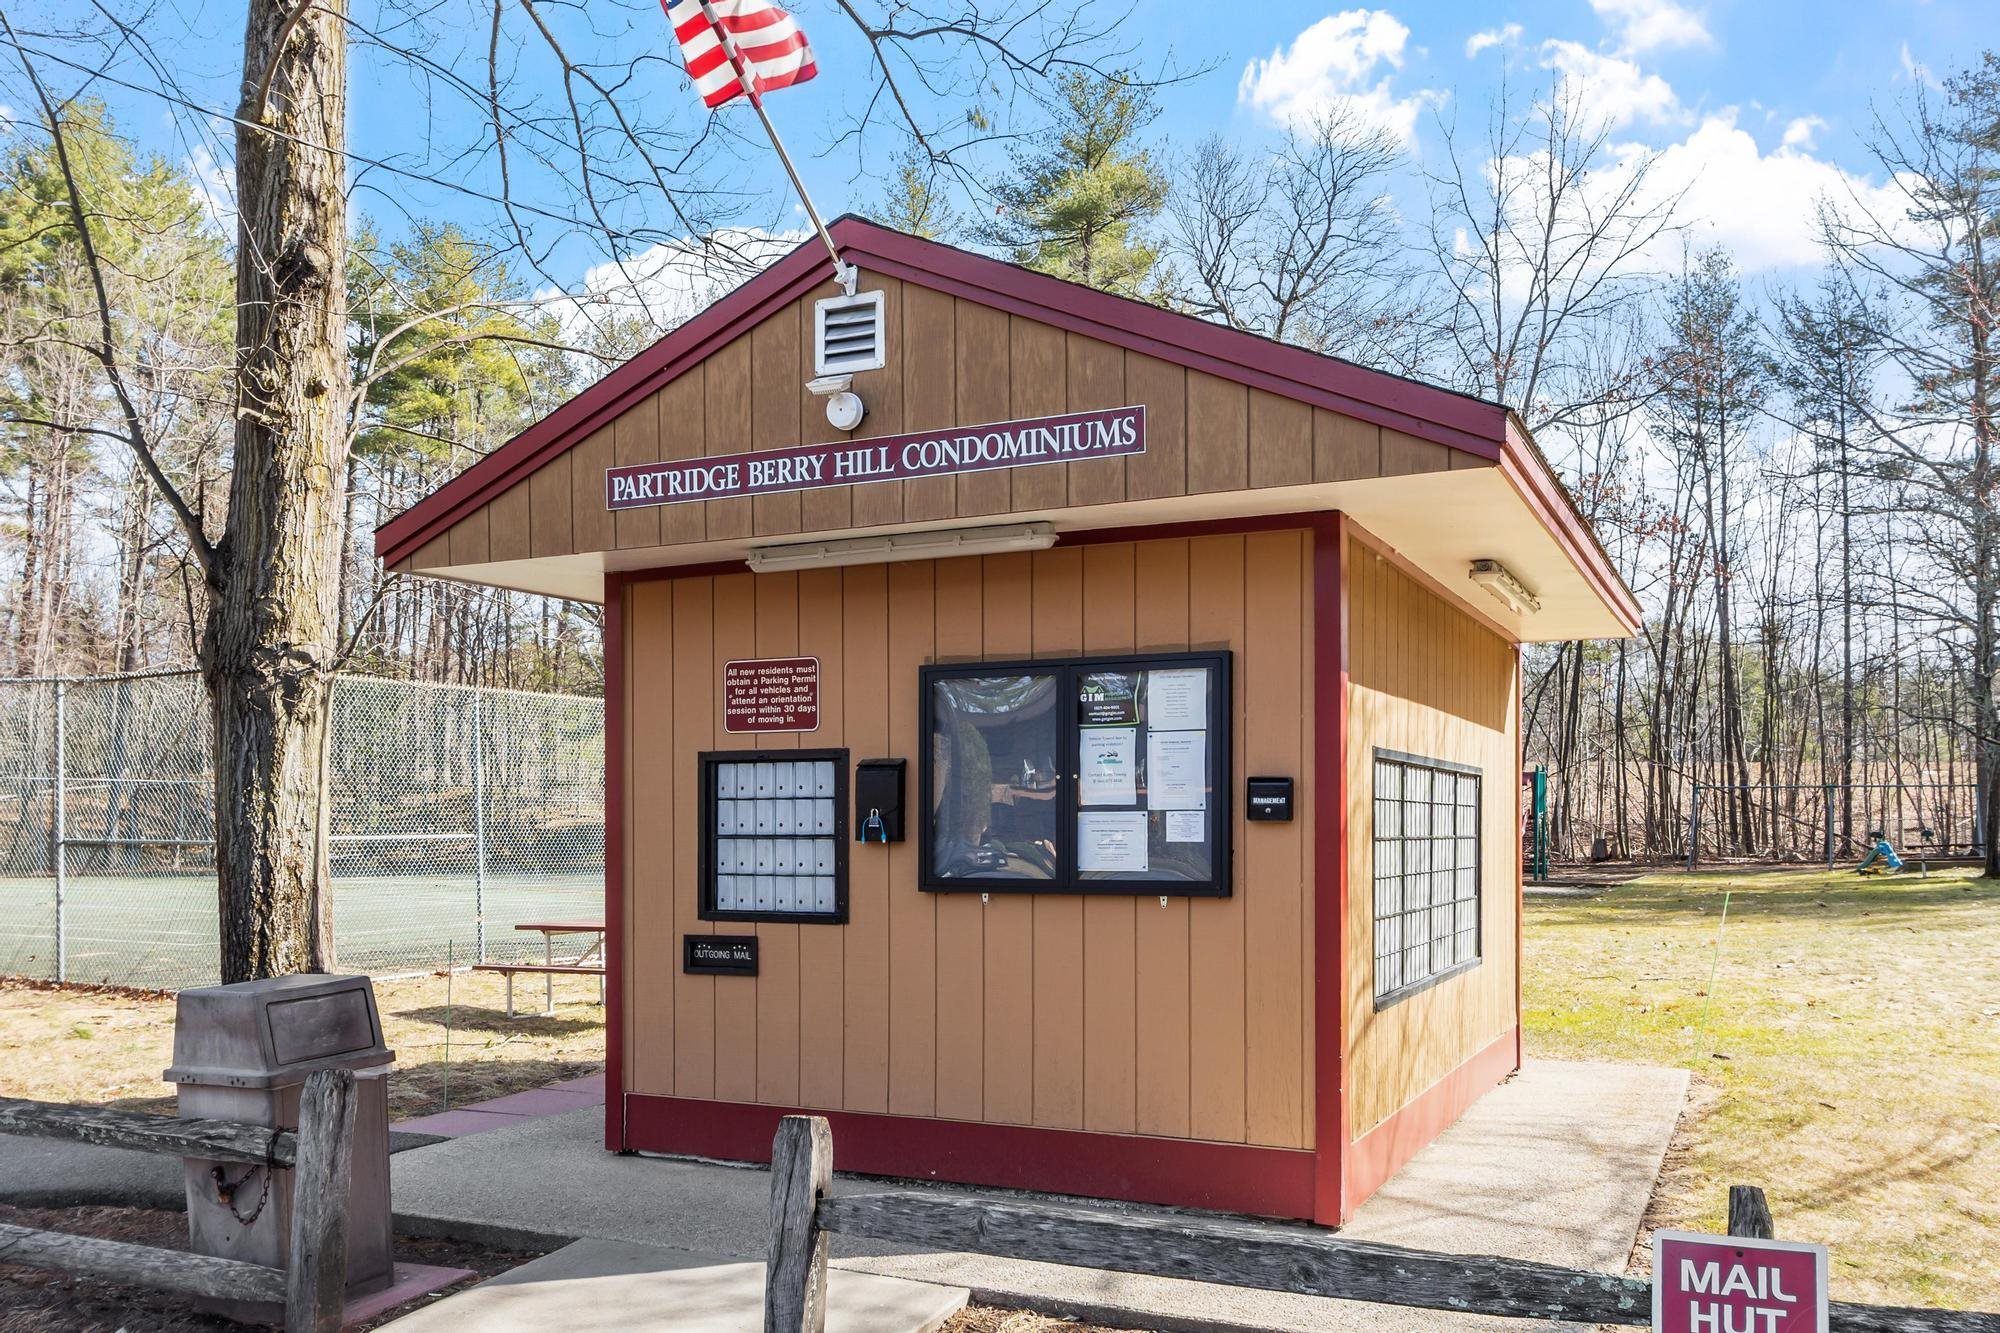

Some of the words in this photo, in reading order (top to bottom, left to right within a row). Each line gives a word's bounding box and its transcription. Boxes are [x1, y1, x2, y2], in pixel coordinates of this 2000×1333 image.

[612, 464, 740, 501] PARTRIDGE
[747, 454, 827, 487] BERRY
[834, 446, 895, 478] HILL
[902, 416, 1137, 470] CONDOMINIUMS
[727, 668, 738, 677] All
[757, 666, 794, 675] residents
[796, 665, 816, 673] must
[726, 678, 751, 686] obtain
[760, 676, 789, 686] Parking
[791, 675, 817, 683] Permit
[735, 688, 746, 696] for
[748, 687, 758, 695] all
[760, 686, 791, 694] vehicles
[794, 685, 809, 693] and
[731, 697, 756, 705] attend
[770, 695, 812, 703] orientation
[727, 707, 757, 715] session
[759, 705, 782, 714] within
[783, 705, 795, 713] 30
[797, 704, 817, 714] days
[747, 716, 756, 724] of
[757, 715, 784, 725] moving
[786, 715, 796, 723] in.
[693, 949, 731, 959] OUTGOING
[733, 951, 752, 961] MAIL
[1680, 1259, 1797, 1303] MAIL
[1690, 1300, 1788, 1333] HUT
